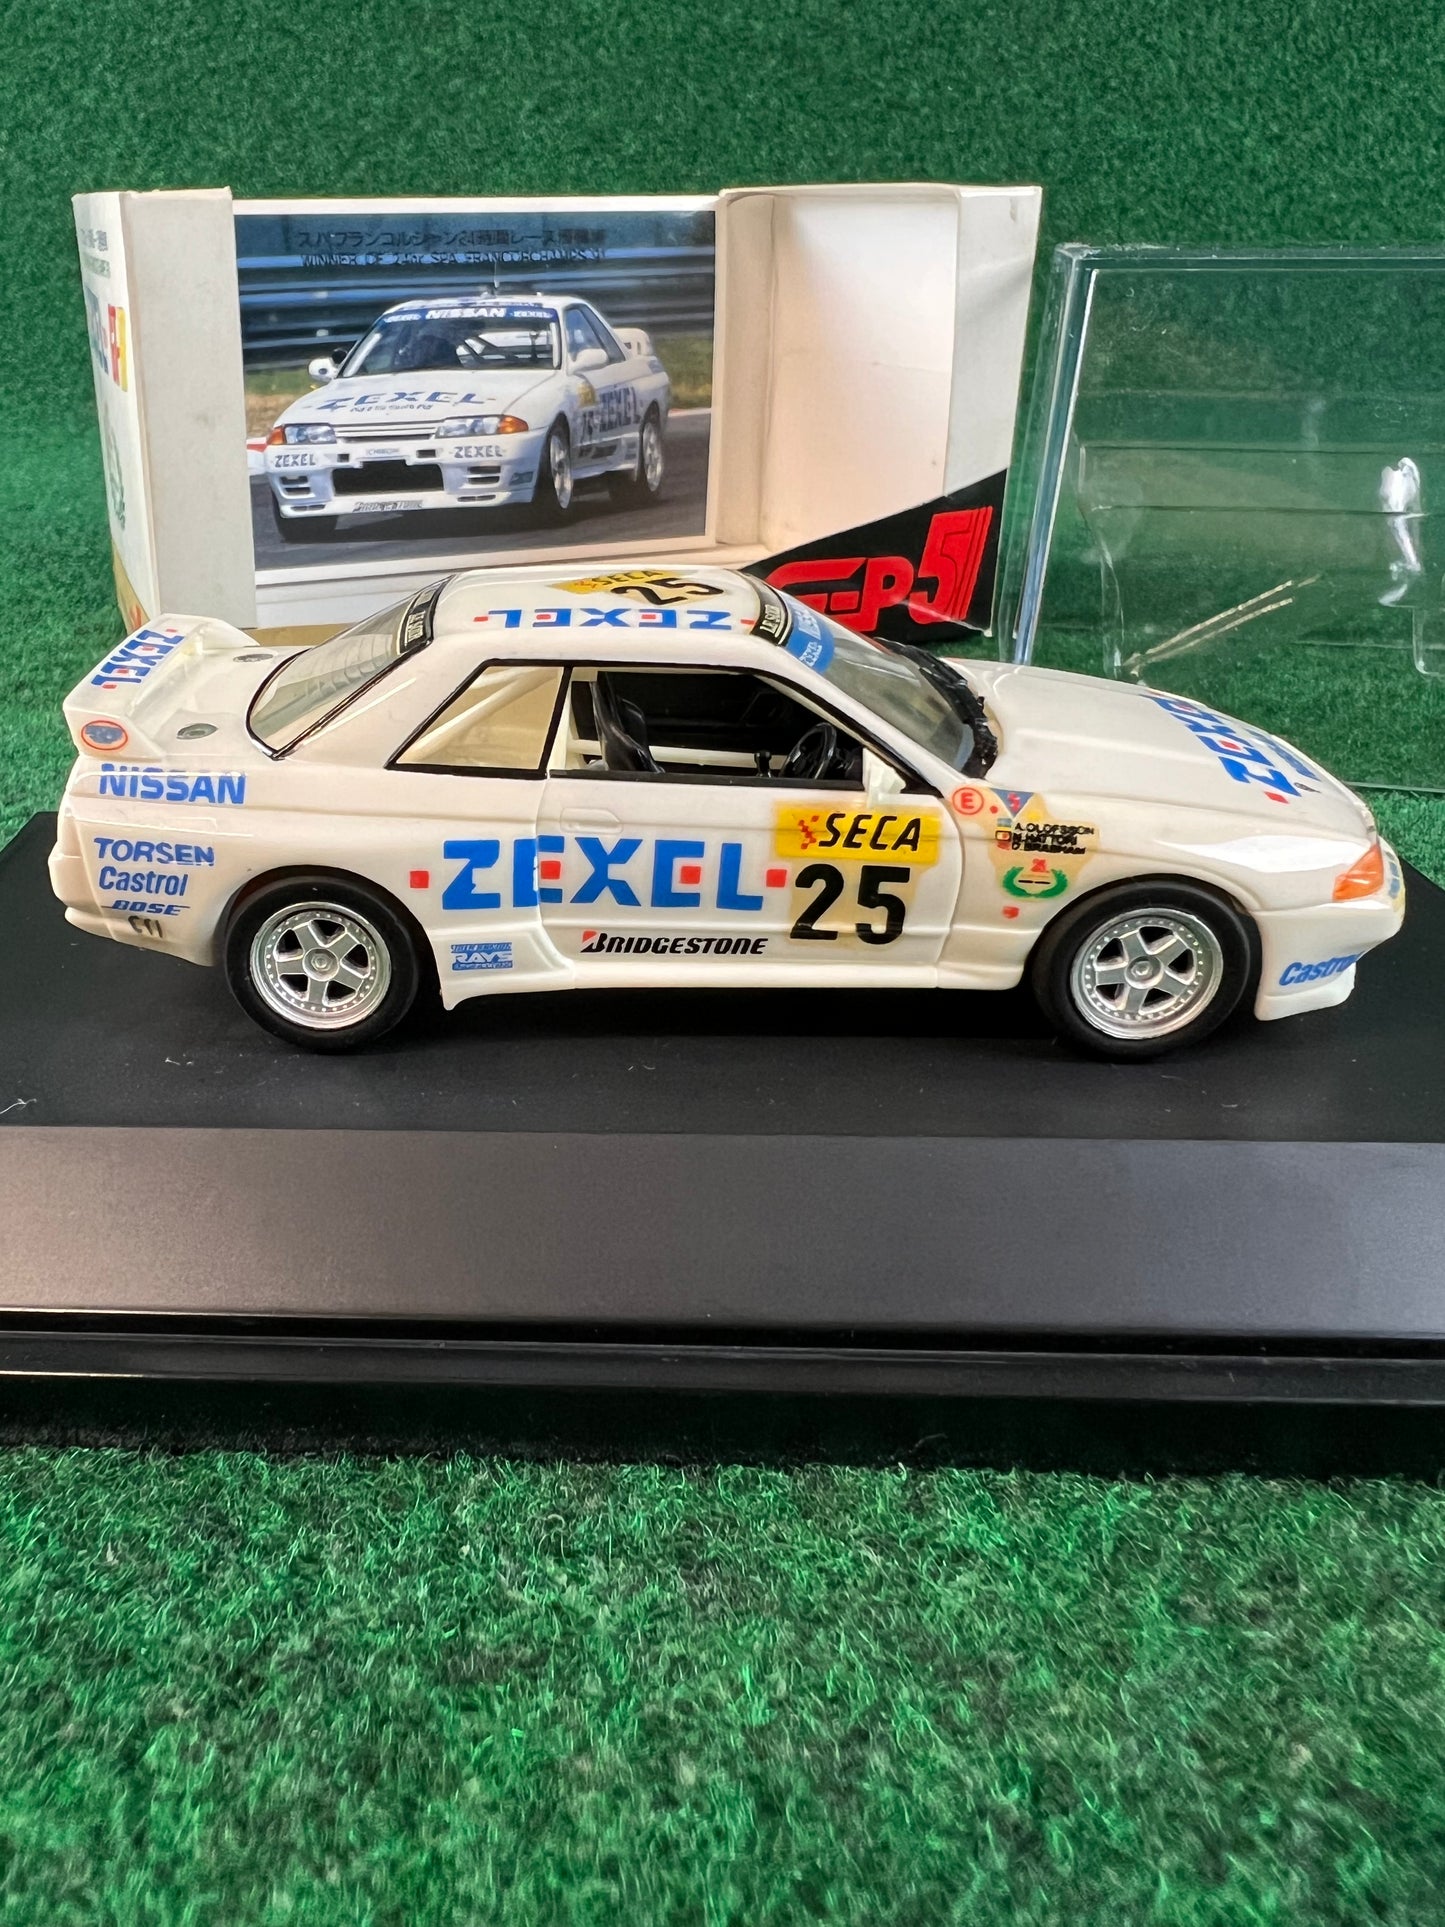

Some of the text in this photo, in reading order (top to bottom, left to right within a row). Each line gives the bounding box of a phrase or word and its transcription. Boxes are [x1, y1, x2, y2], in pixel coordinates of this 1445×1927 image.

[425, 308, 507, 320] NISSAN
[316, 391, 485, 412] ZEXEL
[274, 453, 317, 468] ZEXEL
[453, 445, 504, 459] ZEXEL
[591, 569, 664, 586] SECA
[610, 577, 724, 606] 25
[487, 607, 733, 631] ZEXEL
[91, 629, 185, 686] ZEXEL
[99, 763, 246, 805] NISSAN
[818, 812, 921, 852] SECA
[94, 837, 215, 867] TORSEN
[99, 866, 189, 897] Castrol
[442, 834, 764, 911] ZEXEL
[108, 900, 185, 916] BOSE
[789, 863, 911, 945] 25
[580, 930, 769, 955] BRIDGESTONE
[452, 951, 513, 964] RAYS
